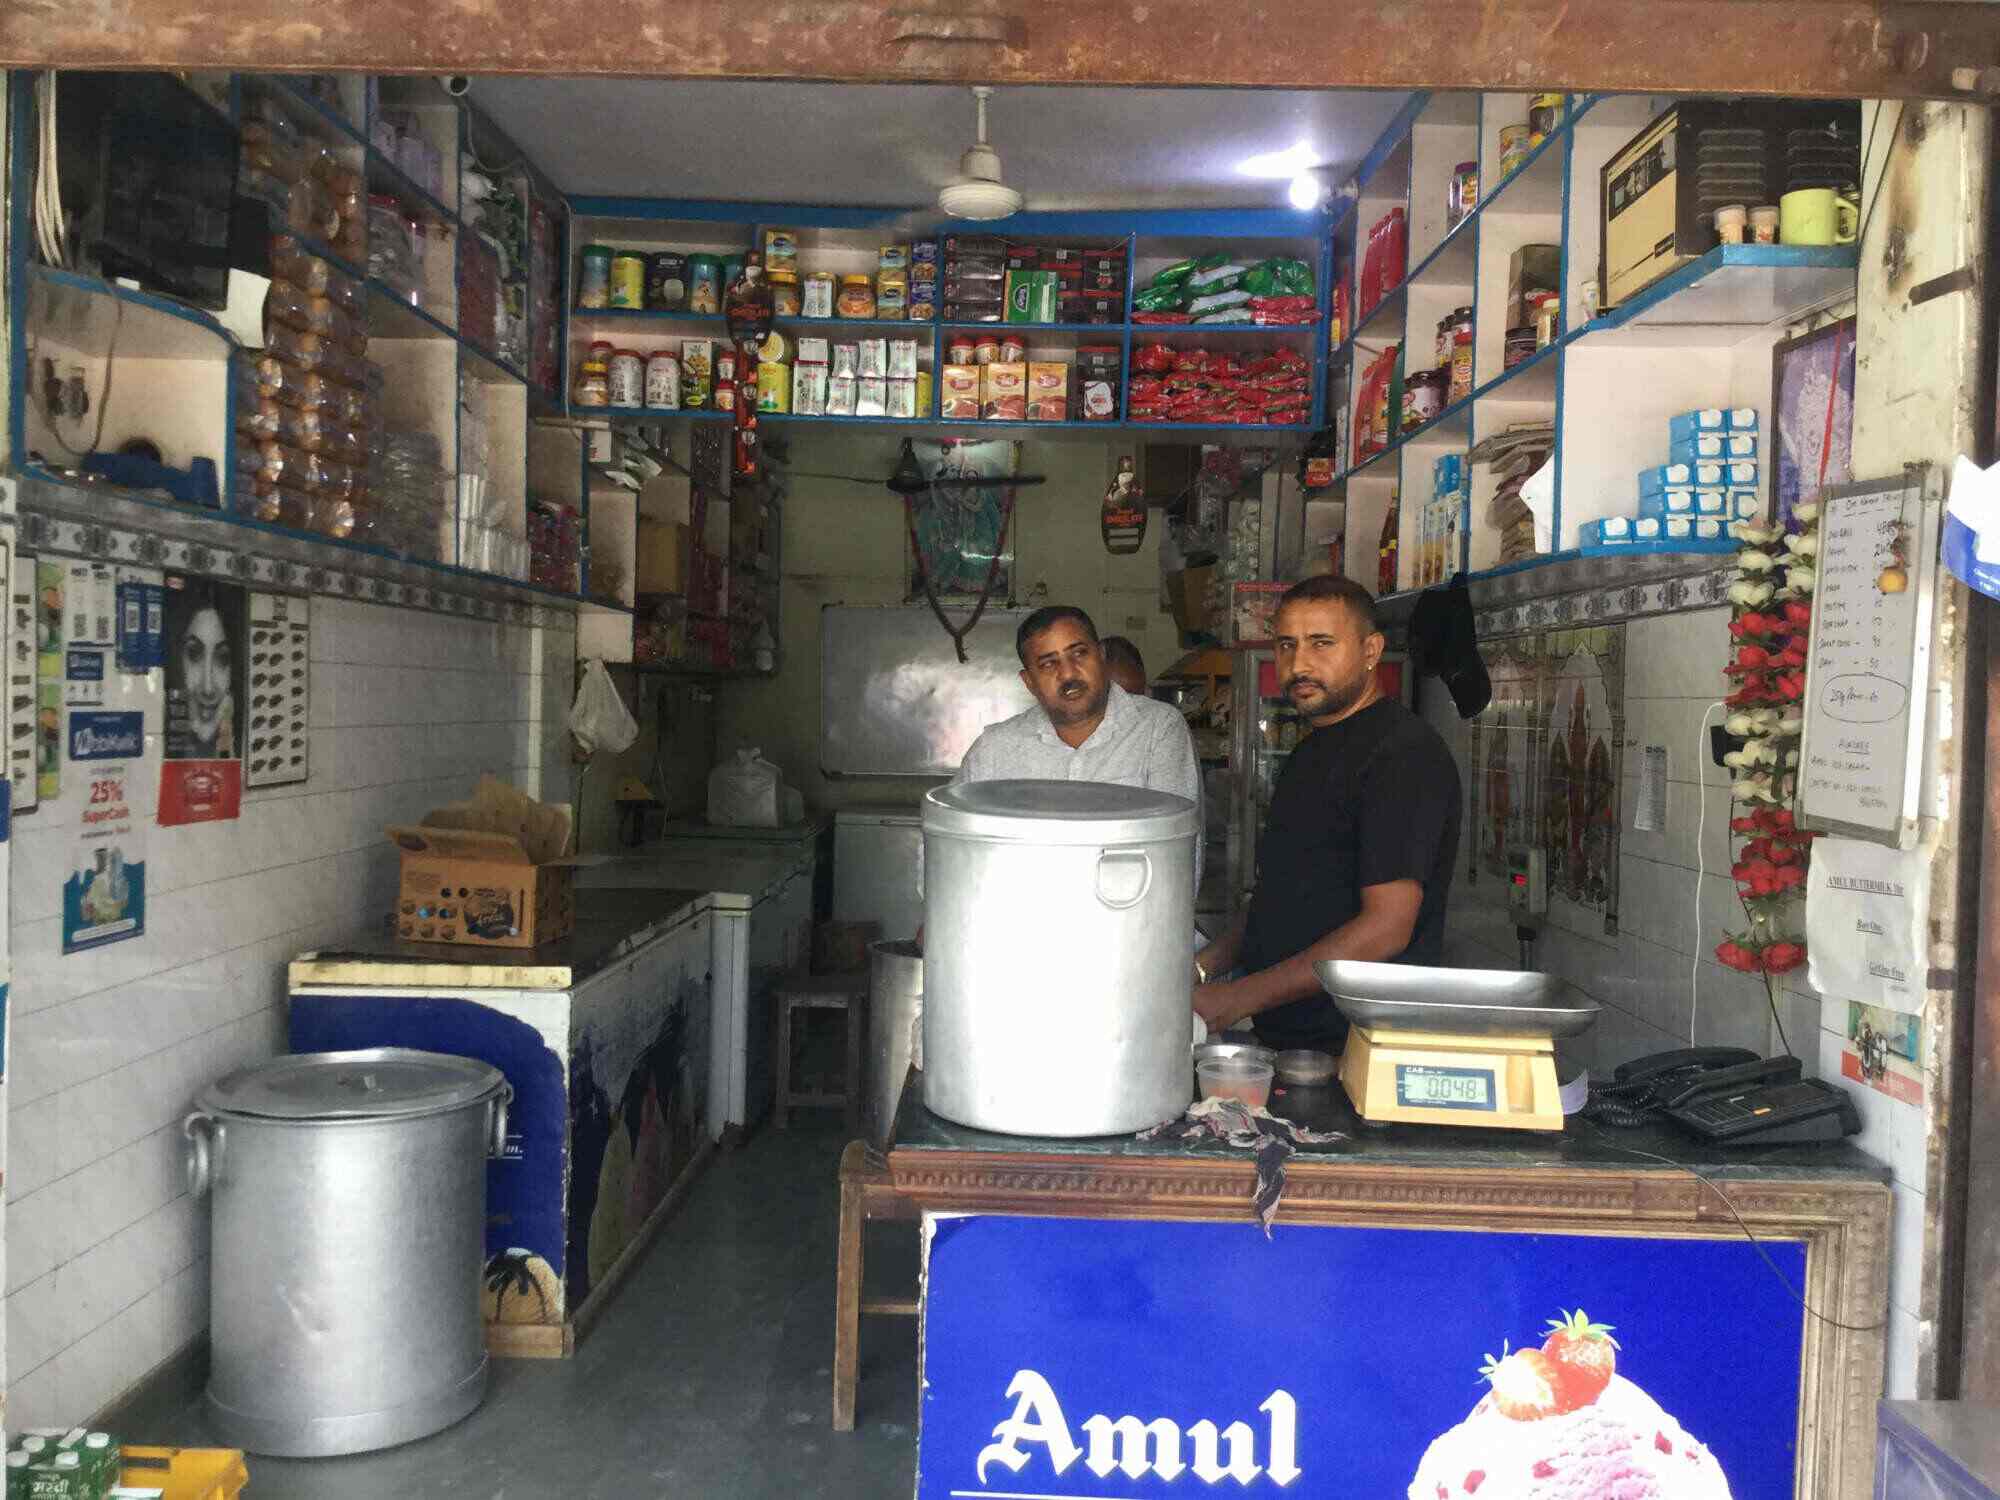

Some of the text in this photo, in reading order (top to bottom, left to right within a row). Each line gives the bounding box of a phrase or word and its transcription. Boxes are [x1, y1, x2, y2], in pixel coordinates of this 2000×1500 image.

[90, 779, 123, 803] 25%
[1849, 878, 1892, 893] BUTTERMILK
[977, 1369, 1301, 1487] Amul
